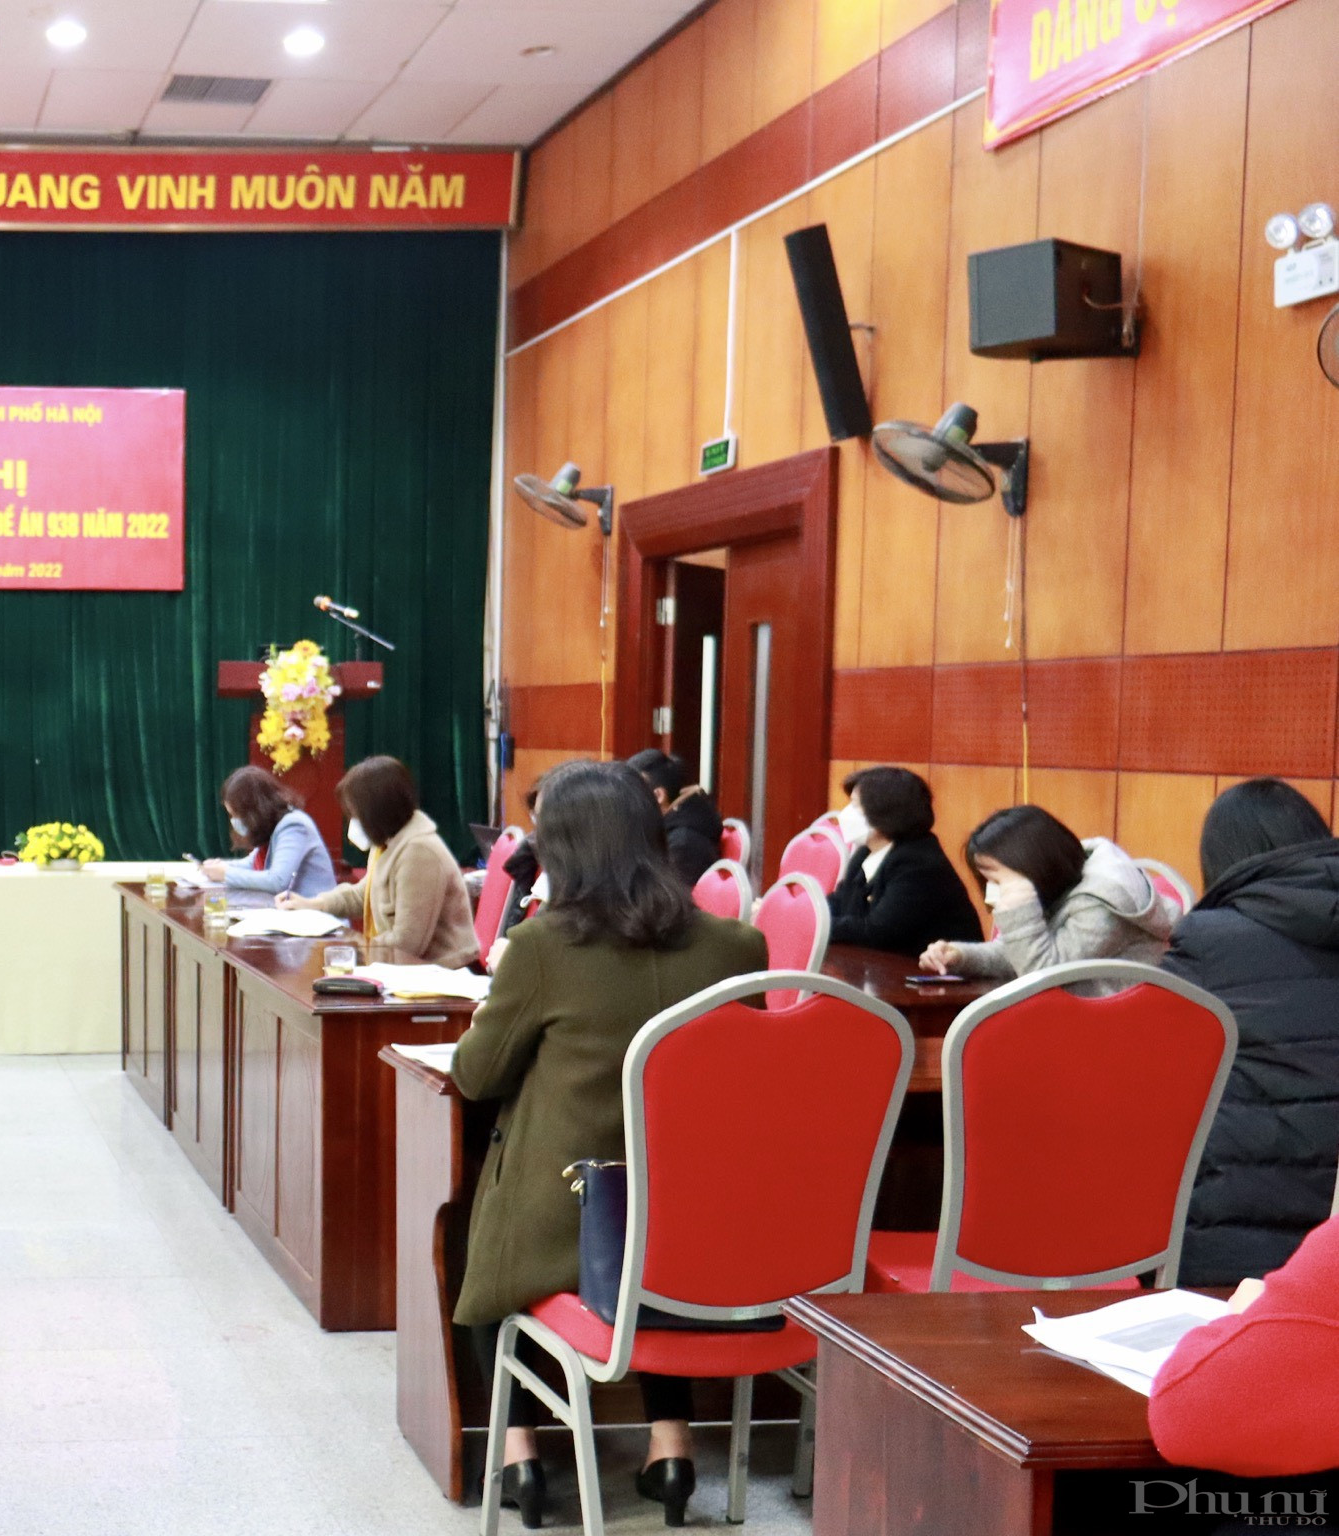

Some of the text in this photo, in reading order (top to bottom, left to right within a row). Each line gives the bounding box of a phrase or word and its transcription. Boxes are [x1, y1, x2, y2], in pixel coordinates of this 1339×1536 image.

[117, 174, 217, 211] VINH
[230, 164, 356, 210] MUÔN
[369, 164, 465, 209] NĂM
[8, 402, 43, 423] PHỐ
[45, 402, 69, 423] HÀ
[72, 403, 103, 427] NỘI
[18, 506, 45, 538] ÁN
[82, 507, 125, 539] NĂM
[127, 513, 171, 539] 2022
[28, 563, 63, 579] 2022
